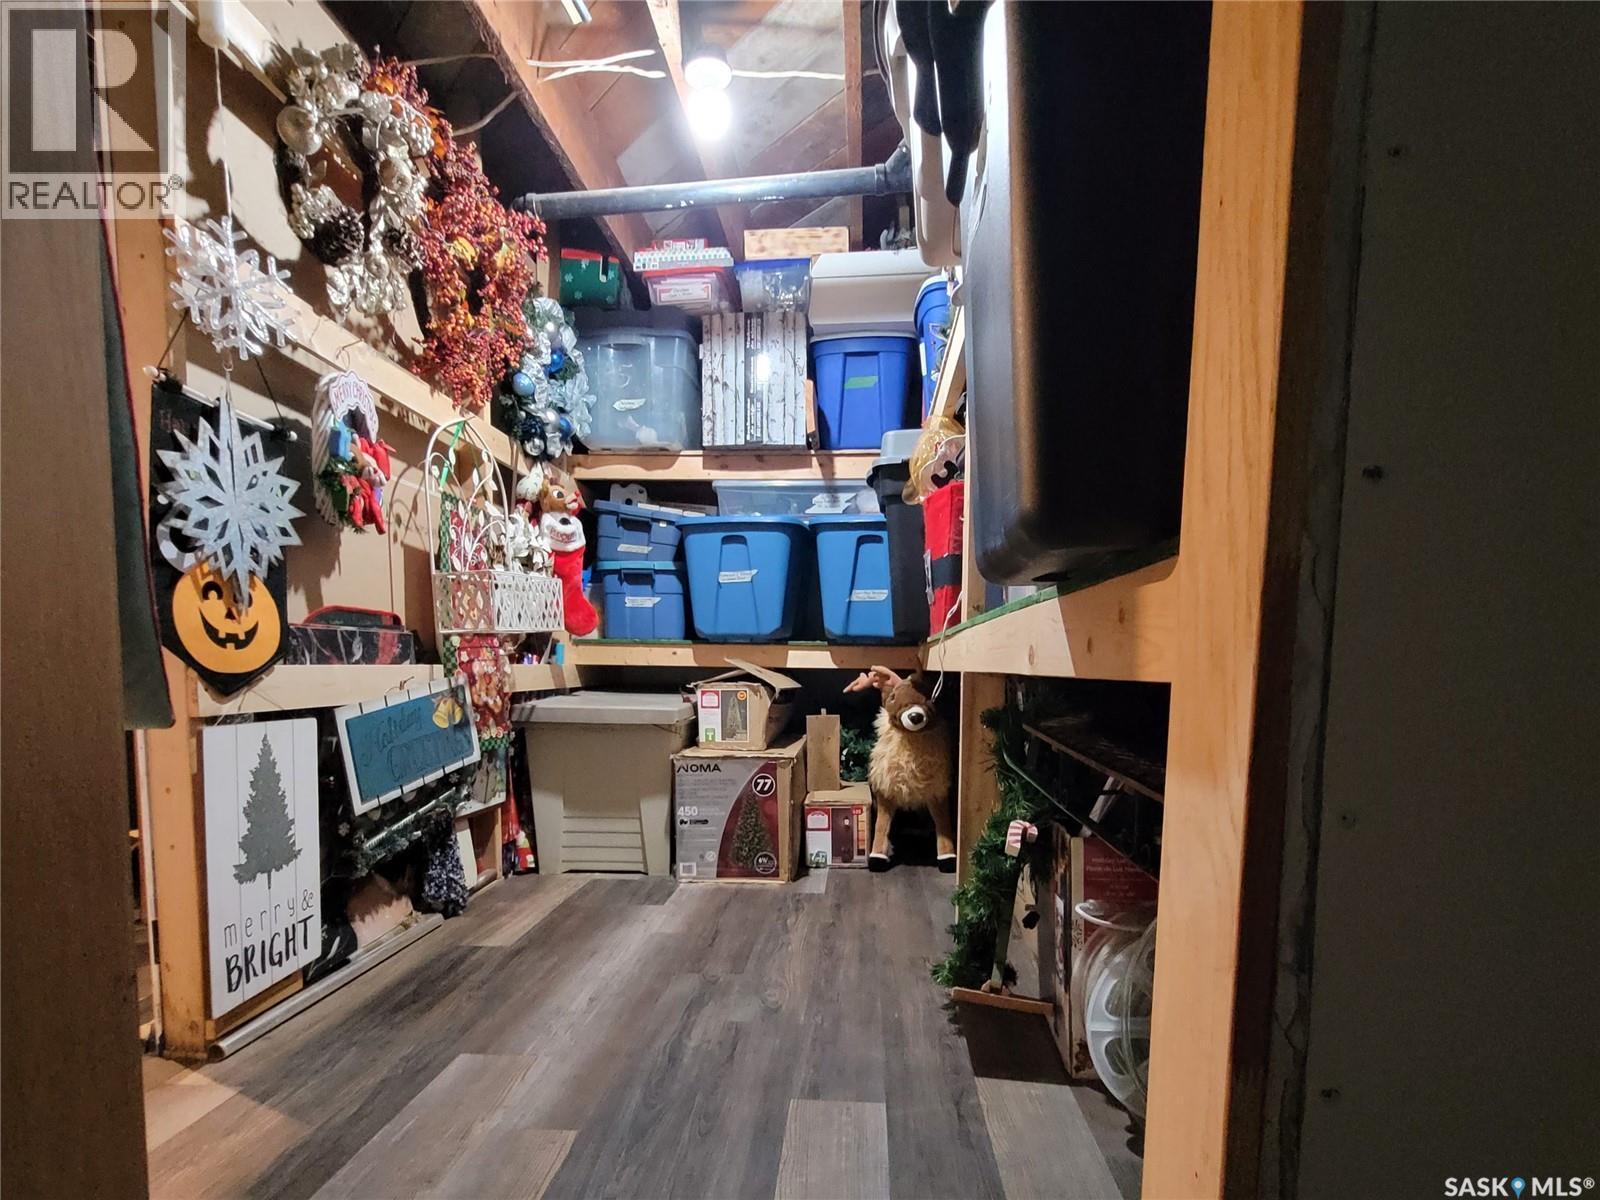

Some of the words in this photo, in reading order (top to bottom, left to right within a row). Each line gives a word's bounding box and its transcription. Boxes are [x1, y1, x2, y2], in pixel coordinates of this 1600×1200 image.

[676, 763, 722, 773] NOMA
[756, 779, 772, 792] 77
[677, 806, 698, 816] 450
[223, 896, 296, 949] merry
[301, 889, 315, 912] &
[225, 914, 315, 994] BRIGHT
